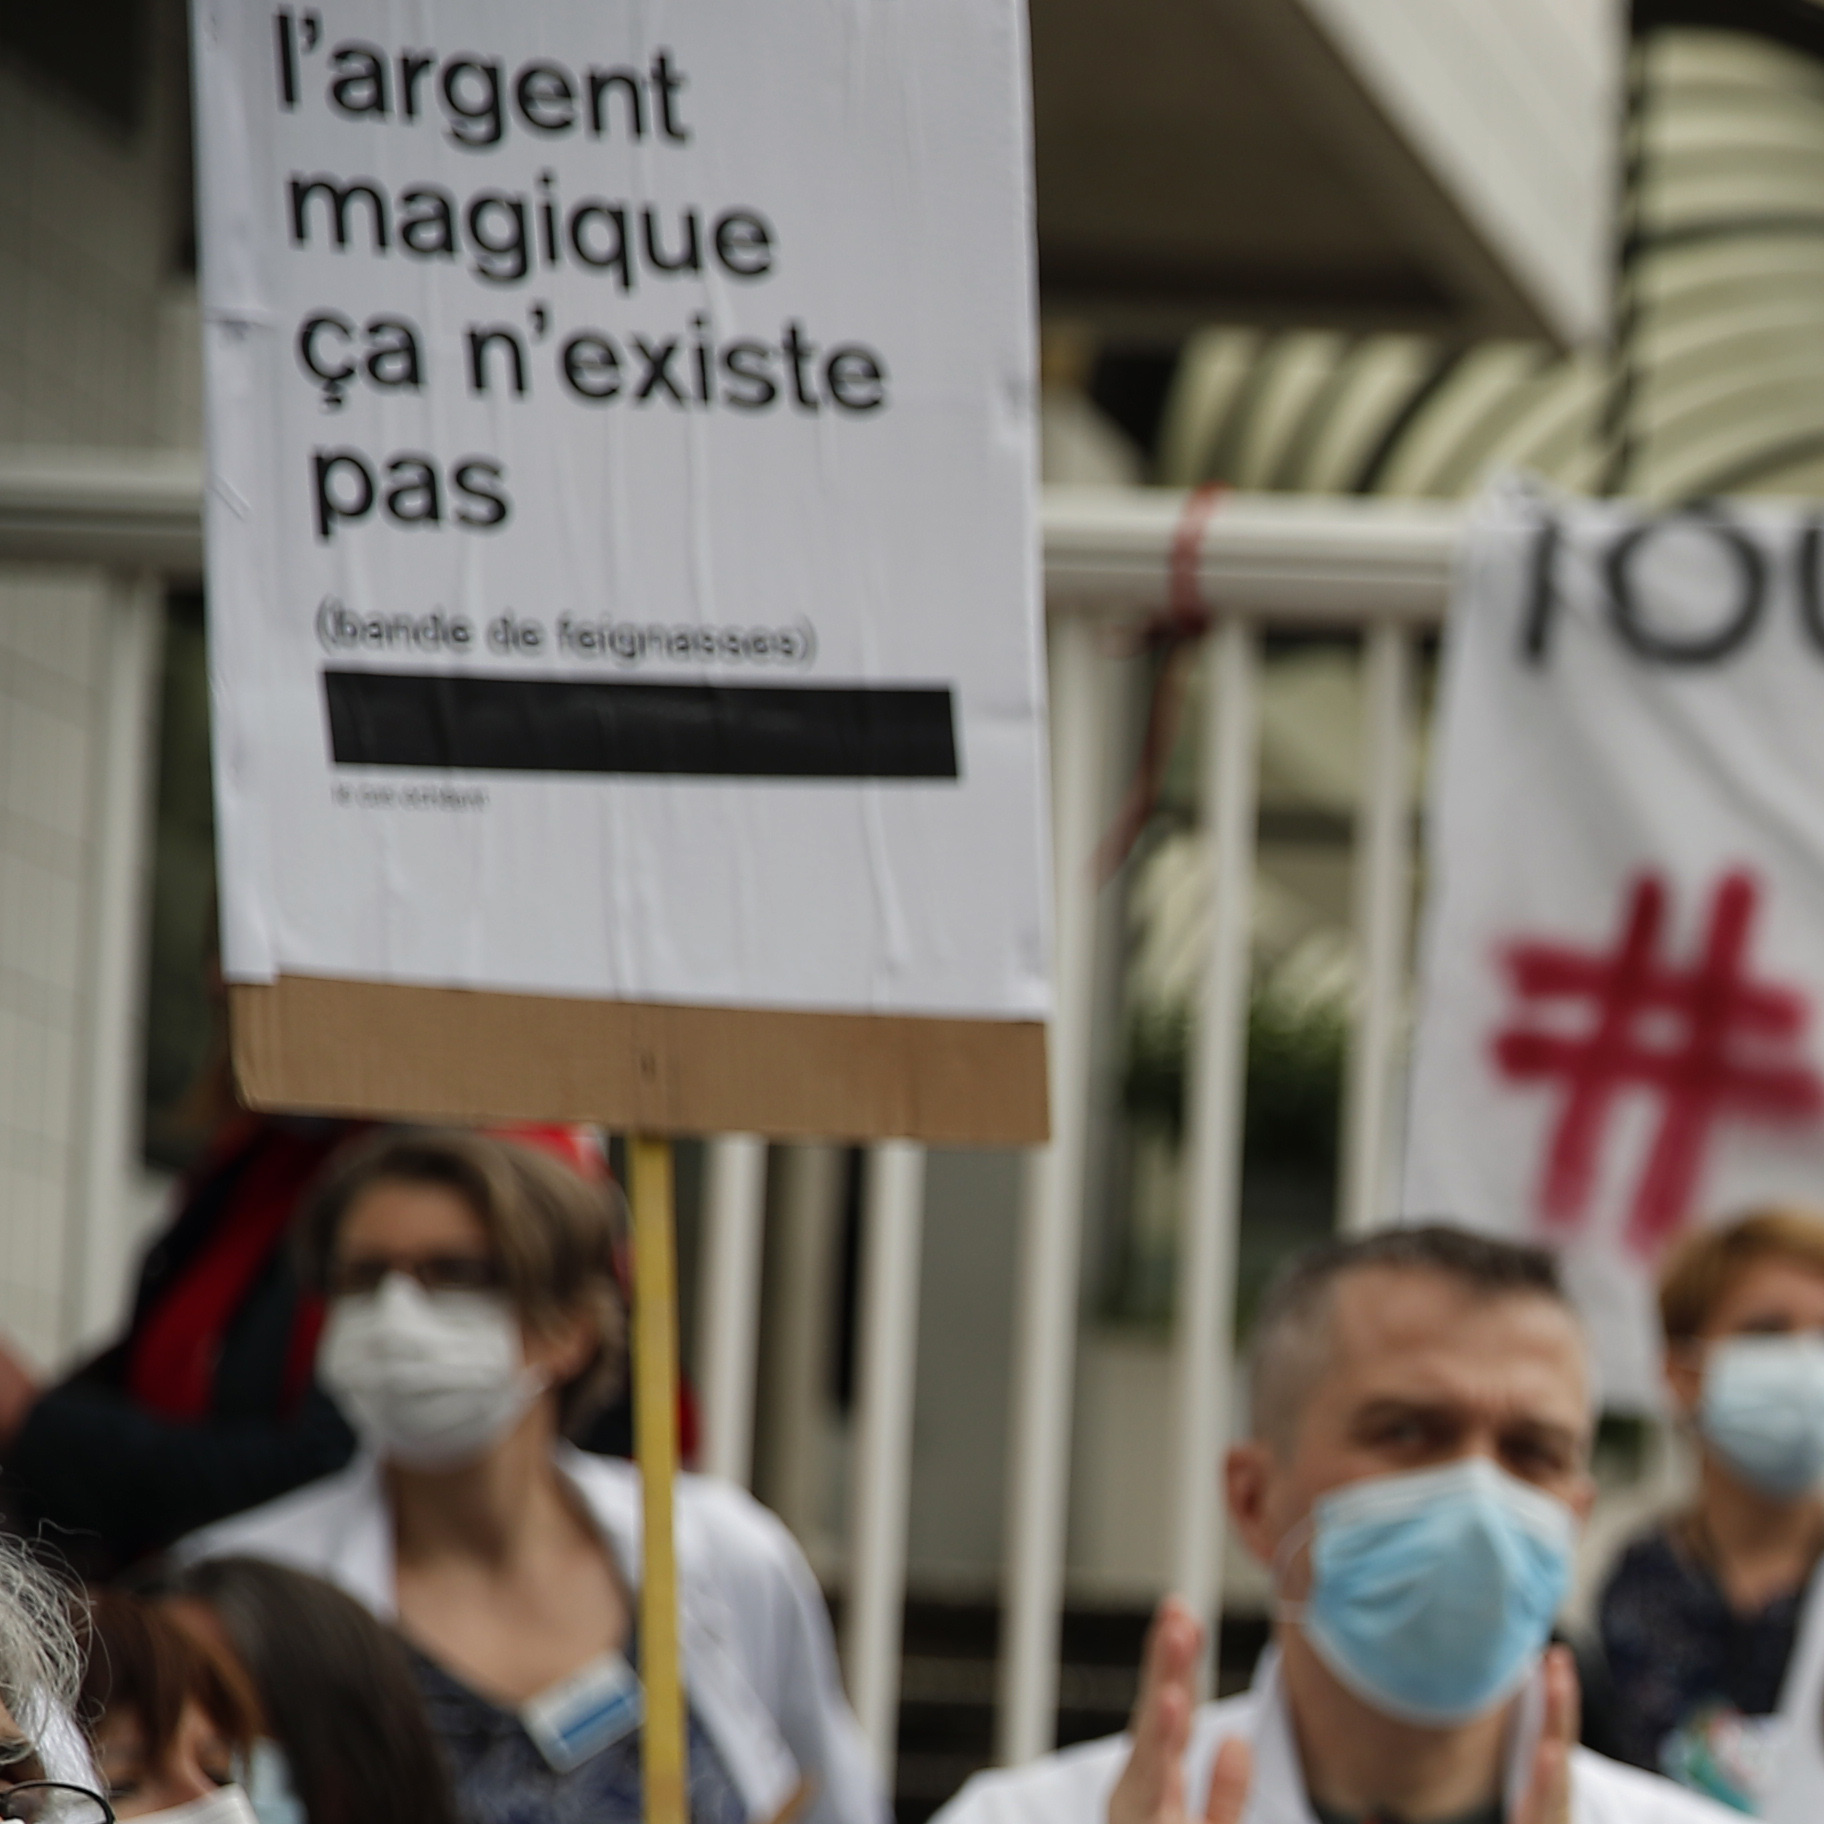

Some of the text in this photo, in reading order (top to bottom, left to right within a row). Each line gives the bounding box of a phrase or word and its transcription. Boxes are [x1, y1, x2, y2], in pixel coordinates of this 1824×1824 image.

[275, 10, 691, 149] l'argent
[289, 171, 776, 290] magique
[298, 306, 885, 417] ça n'existe
[314, 448, 511, 540] pas
[488, 611, 541, 651] de
